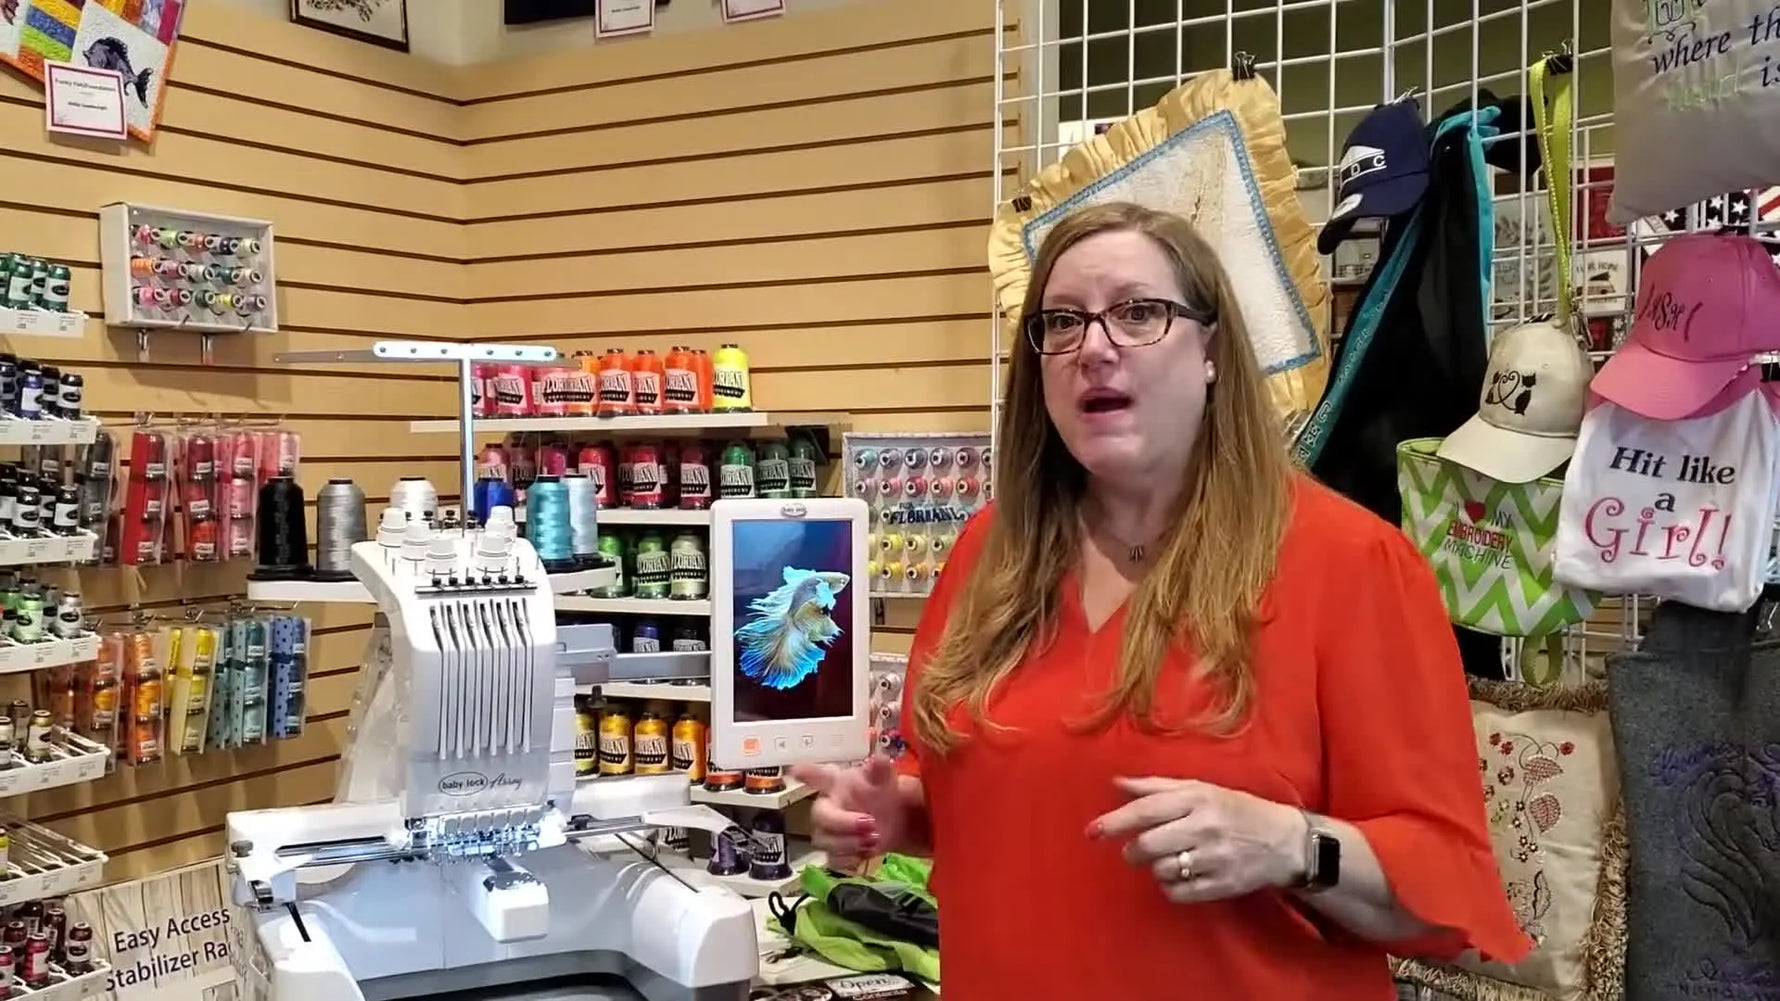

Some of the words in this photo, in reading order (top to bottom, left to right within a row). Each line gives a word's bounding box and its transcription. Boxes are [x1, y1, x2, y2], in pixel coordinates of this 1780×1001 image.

[1651, 32, 1731, 74] where
[1609, 446, 1667, 478] Hit
[1677, 455, 1735, 485] like
[1491, 508, 1513, 529] MY
[1654, 492, 1676, 513] a
[1446, 519, 1514, 553] EMBROIDERY
[1585, 496, 1732, 571] Girl!
[1443, 538, 1513, 570] MACHINE
[442, 781, 464, 791] baby
[466, 778, 485, 788] lock
[113, 926, 160, 954] Easy
[166, 908, 231, 939] Access
[840, 977, 888, 993] Open
